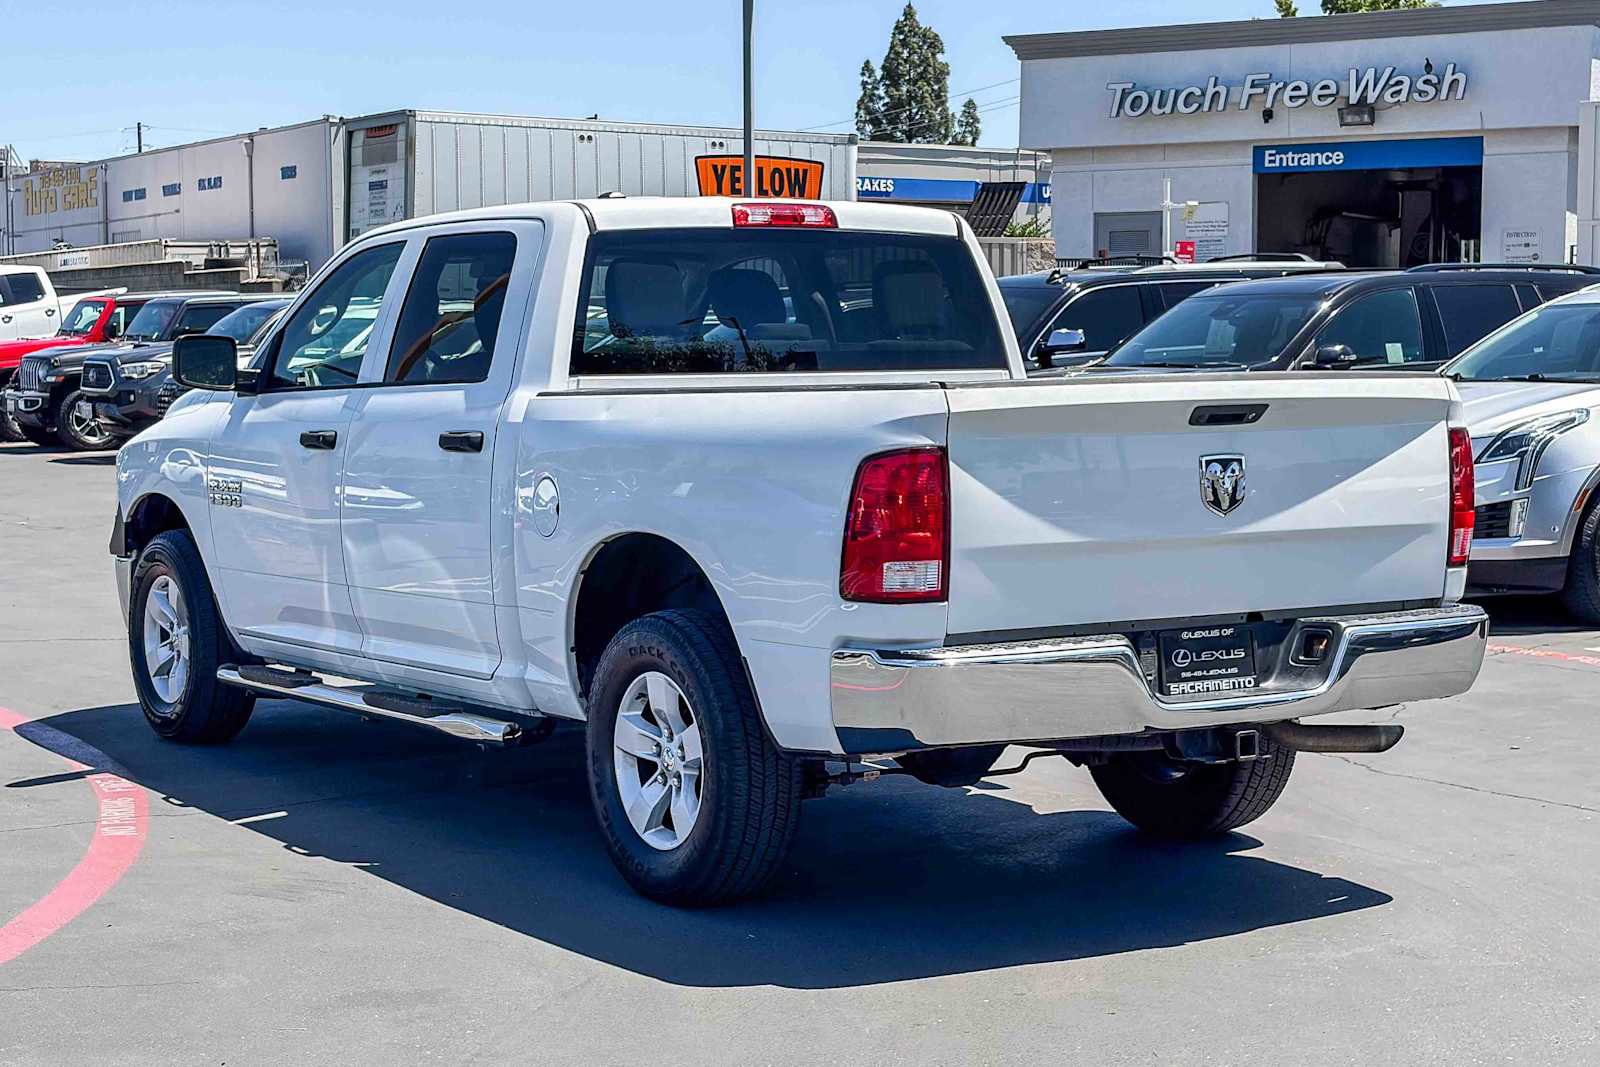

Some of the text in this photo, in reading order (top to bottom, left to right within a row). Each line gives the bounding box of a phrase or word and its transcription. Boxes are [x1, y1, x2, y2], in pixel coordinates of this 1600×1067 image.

[1106, 63, 1468, 119] Touch Free Wash
[1264, 149, 1344, 168] Entrance
[712, 164, 809, 198] YELOW
[856, 178, 895, 192] RAKES
[1189, 628, 1235, 639] LEXUS OF
[1193, 648, 1246, 662] LEXUS
[1169, 677, 1255, 695] SACRAMENTO
